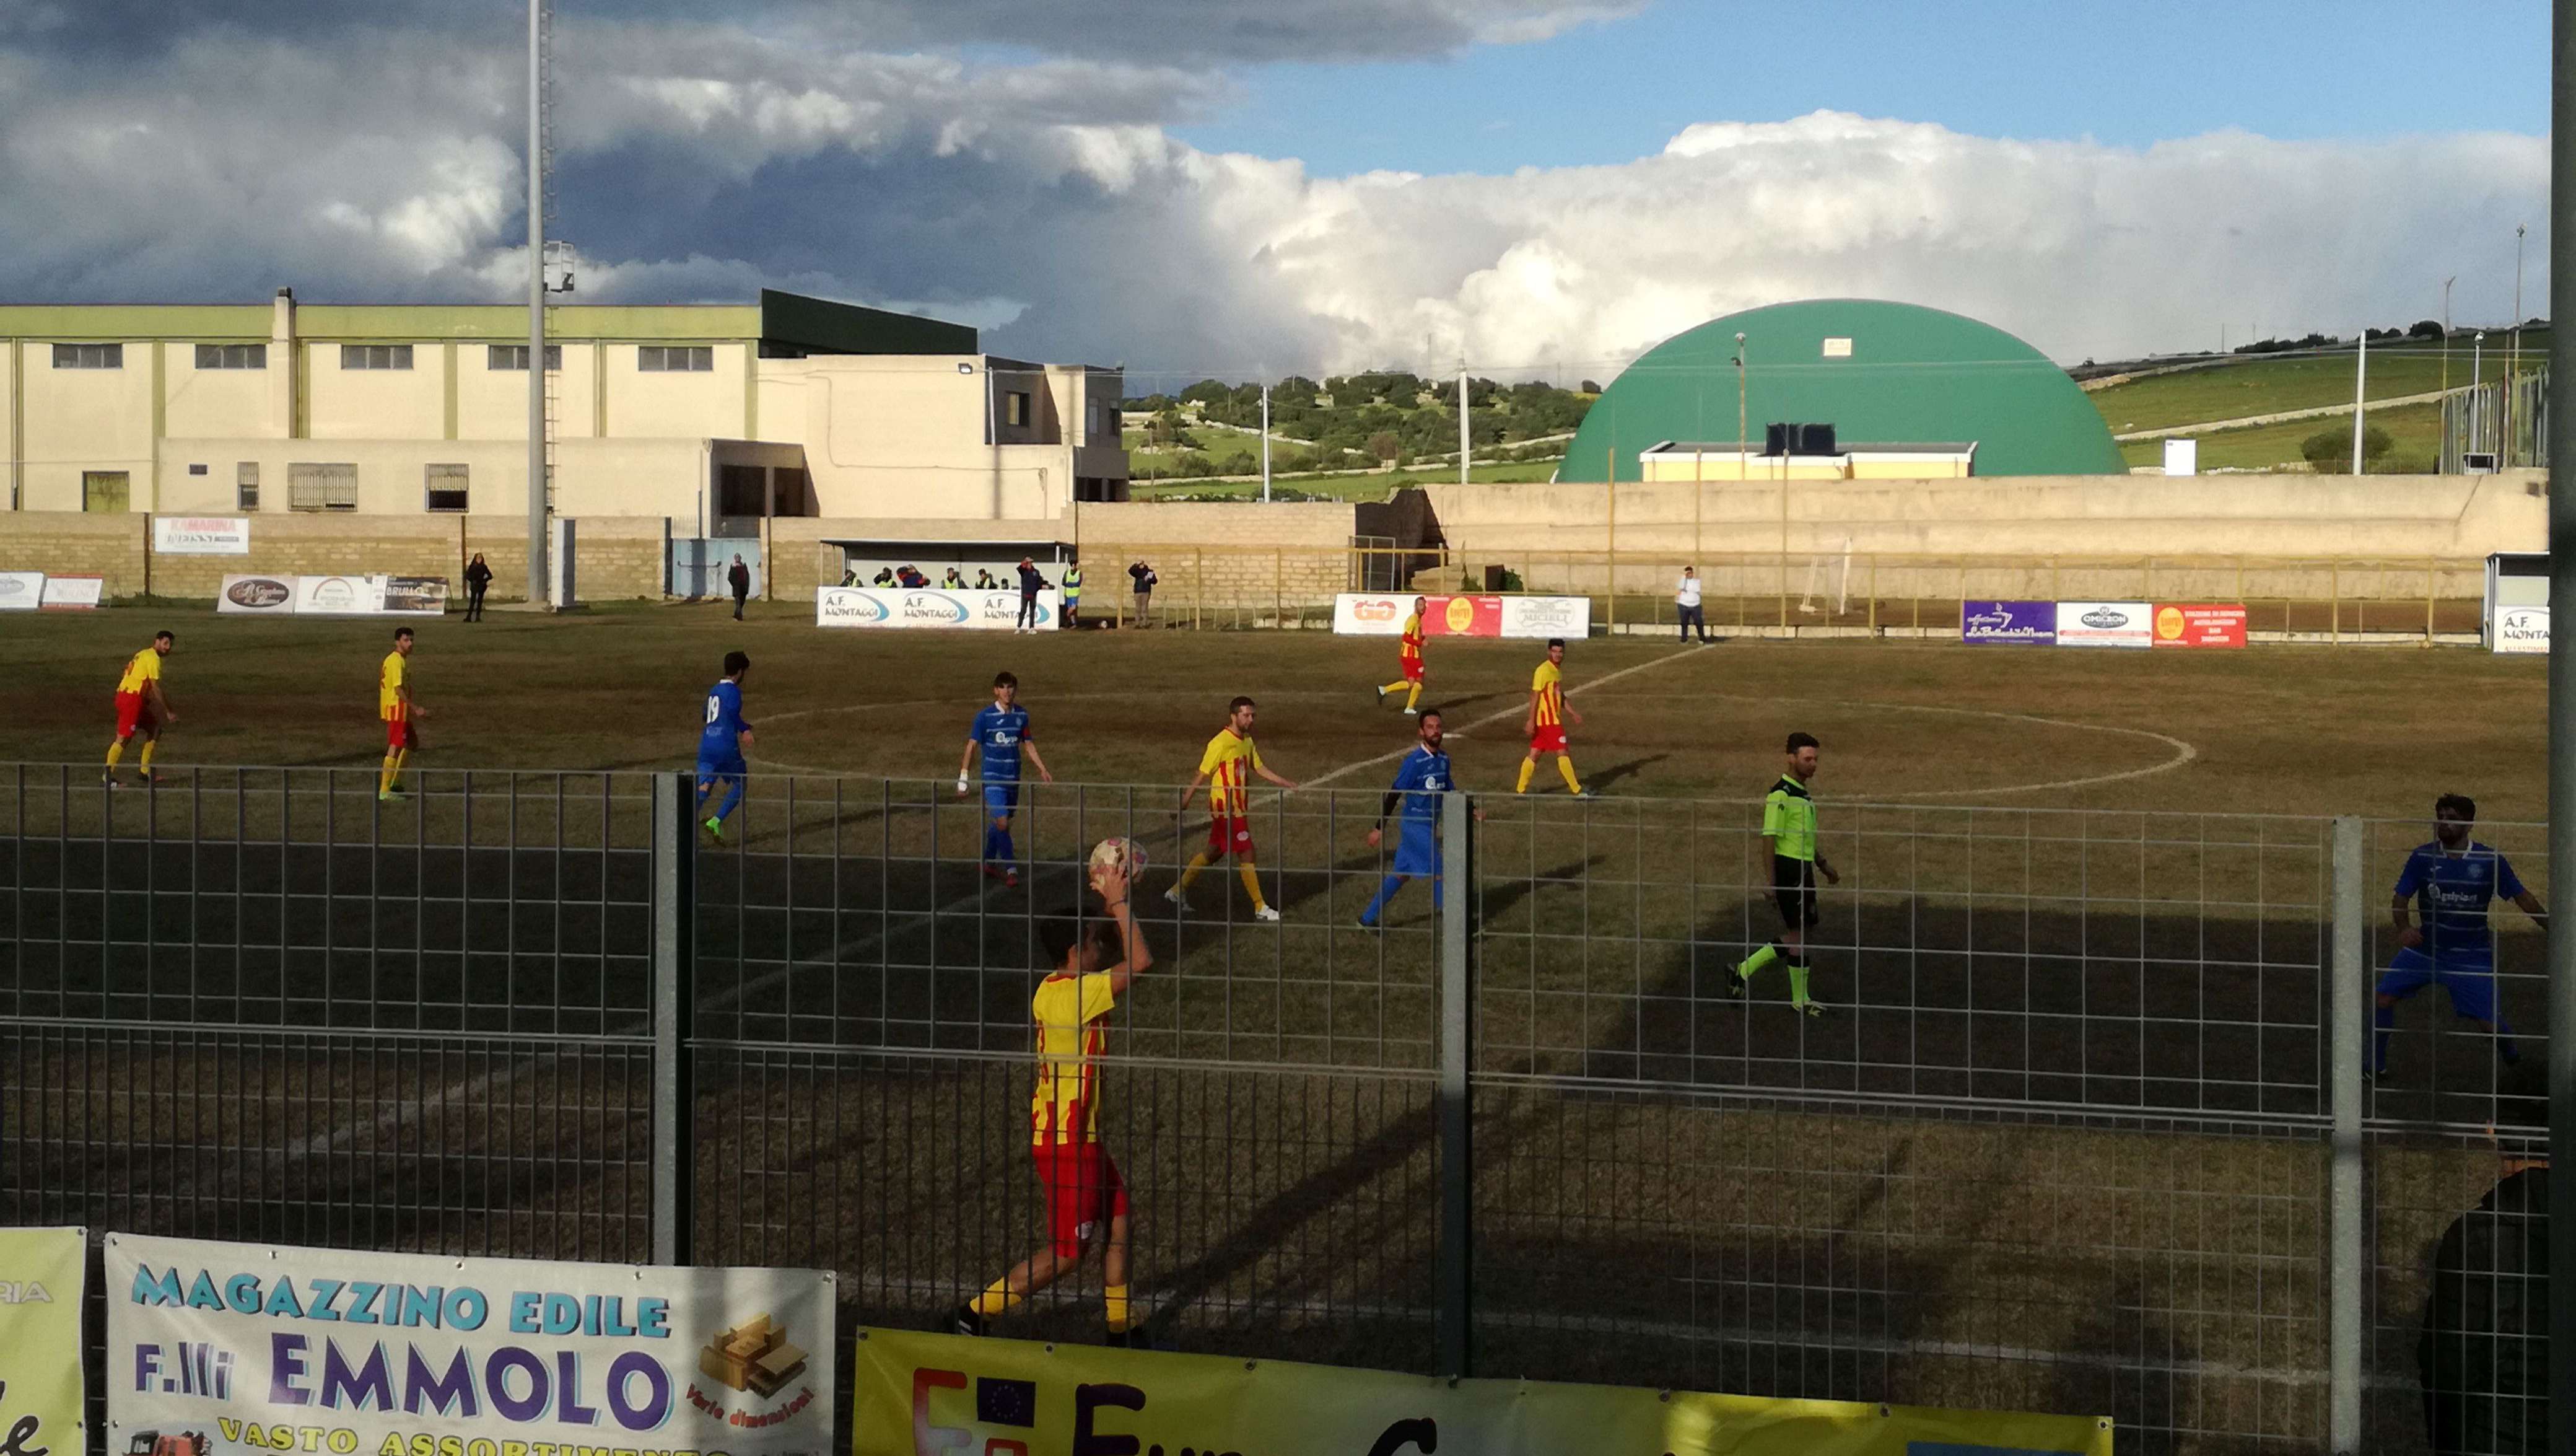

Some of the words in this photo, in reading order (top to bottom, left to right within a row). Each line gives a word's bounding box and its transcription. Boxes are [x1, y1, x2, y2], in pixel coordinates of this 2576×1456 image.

[825, 608, 878, 616] MONTAGGI
[904, 609, 958, 618] MONTAGGI
[2503, 630, 2549, 639] MONTA
[706, 695, 720, 724] 19
[131, 1263, 489, 1331] MAGAZZINO
[510, 1291, 673, 1338] EDILE
[268, 1331, 675, 1432] EMMOLO
[686, 1382, 725, 1419] Varie
[730, 1387, 814, 1429] dimensioni
[217, 1416, 359, 1454] VASTO
[378, 1431, 732, 1456] ASSORT
